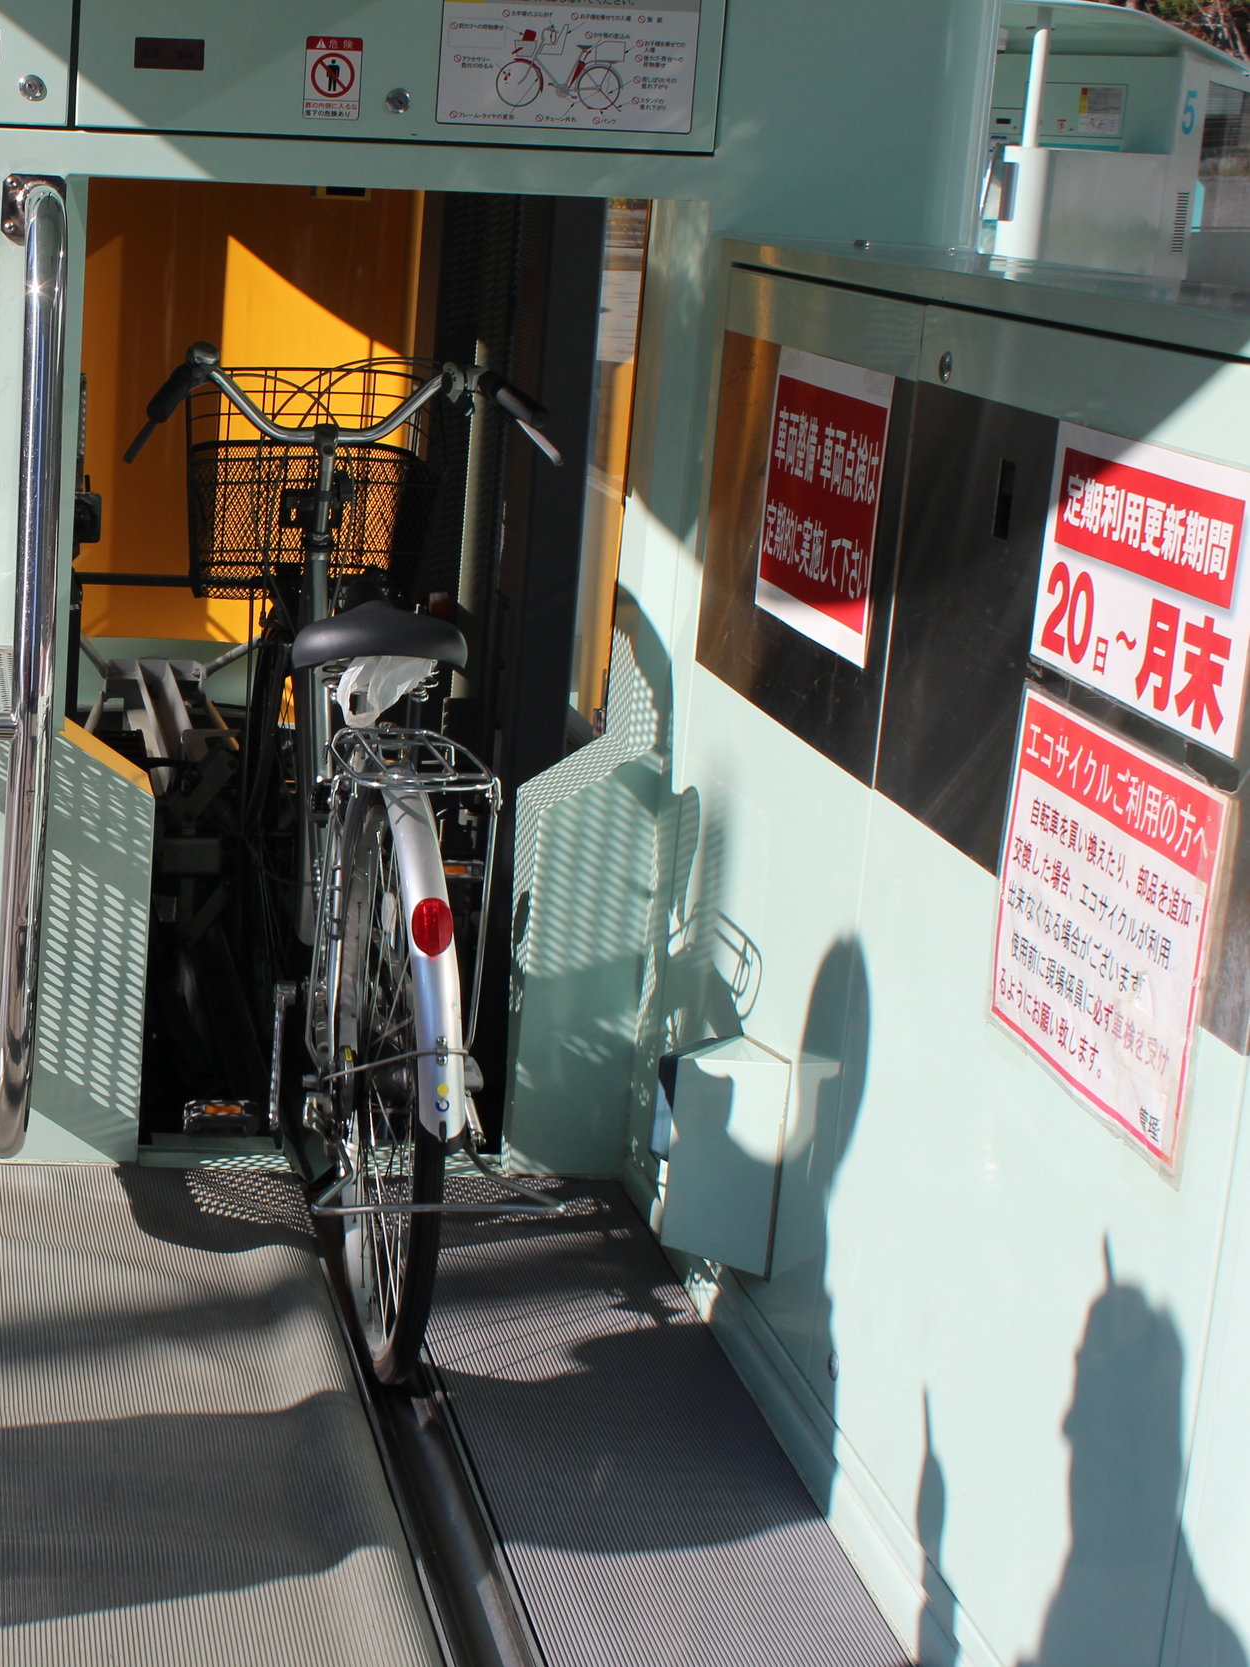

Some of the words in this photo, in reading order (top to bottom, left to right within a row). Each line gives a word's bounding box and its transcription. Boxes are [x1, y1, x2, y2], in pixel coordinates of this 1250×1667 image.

[328, 39, 353, 49] 危険
[1181, 89, 1199, 136] 5
[774, 405, 880, 505] 車両整備・車両点検は
[763, 498, 868, 599] 定期的に実施して下さい
[1063, 473, 1235, 581] 定期利用更新期間
[1025, 723, 1208, 860] エコサイクルご利用の方へ
[1012, 835, 1171, 970] 交換した場合、エコサイクルが利用
[999, 967, 1102, 1079] るようにお願い致します。
